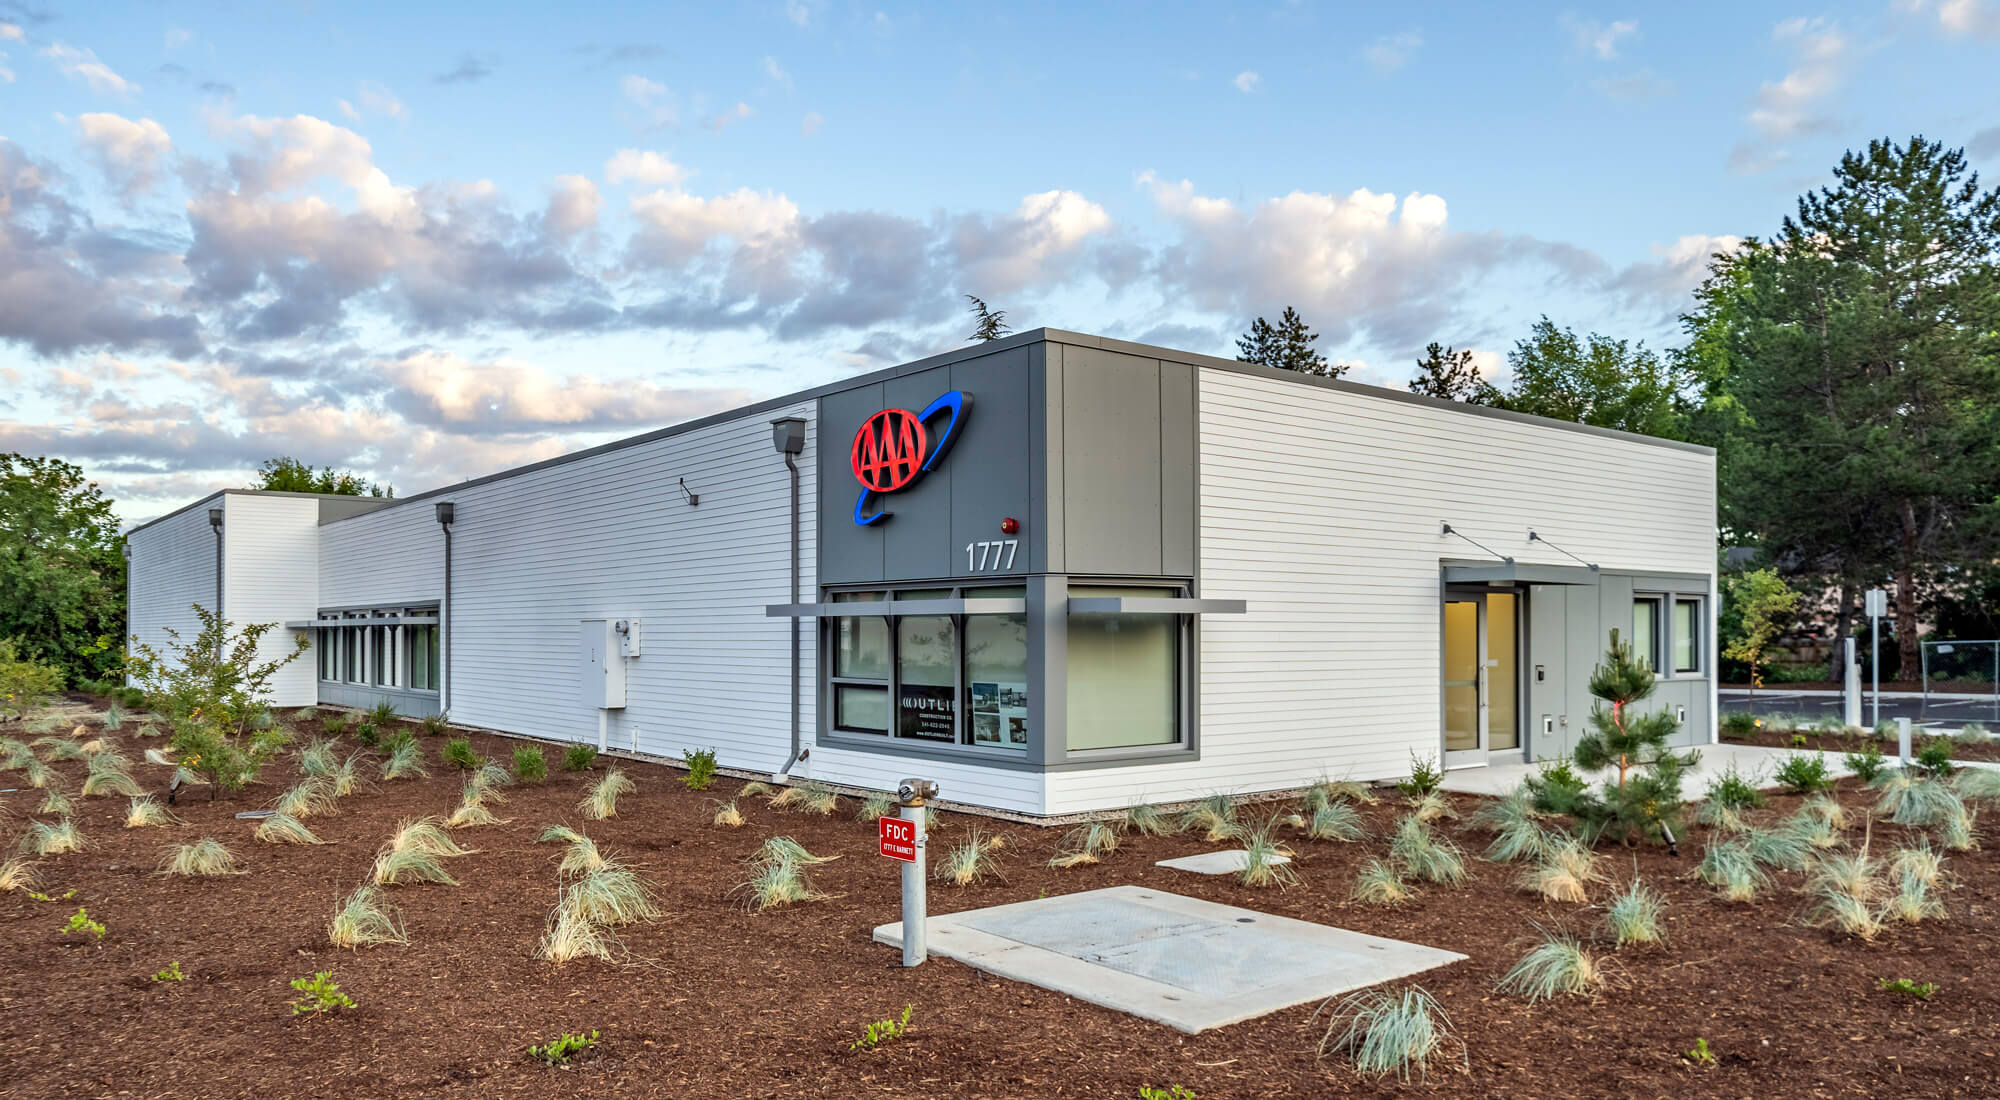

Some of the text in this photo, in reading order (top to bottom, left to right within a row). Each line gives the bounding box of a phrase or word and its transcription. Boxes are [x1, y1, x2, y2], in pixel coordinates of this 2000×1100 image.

[856, 411, 922, 489] AAA
[966, 539, 1018, 571] 1777
[886, 823, 908, 841] FDC
